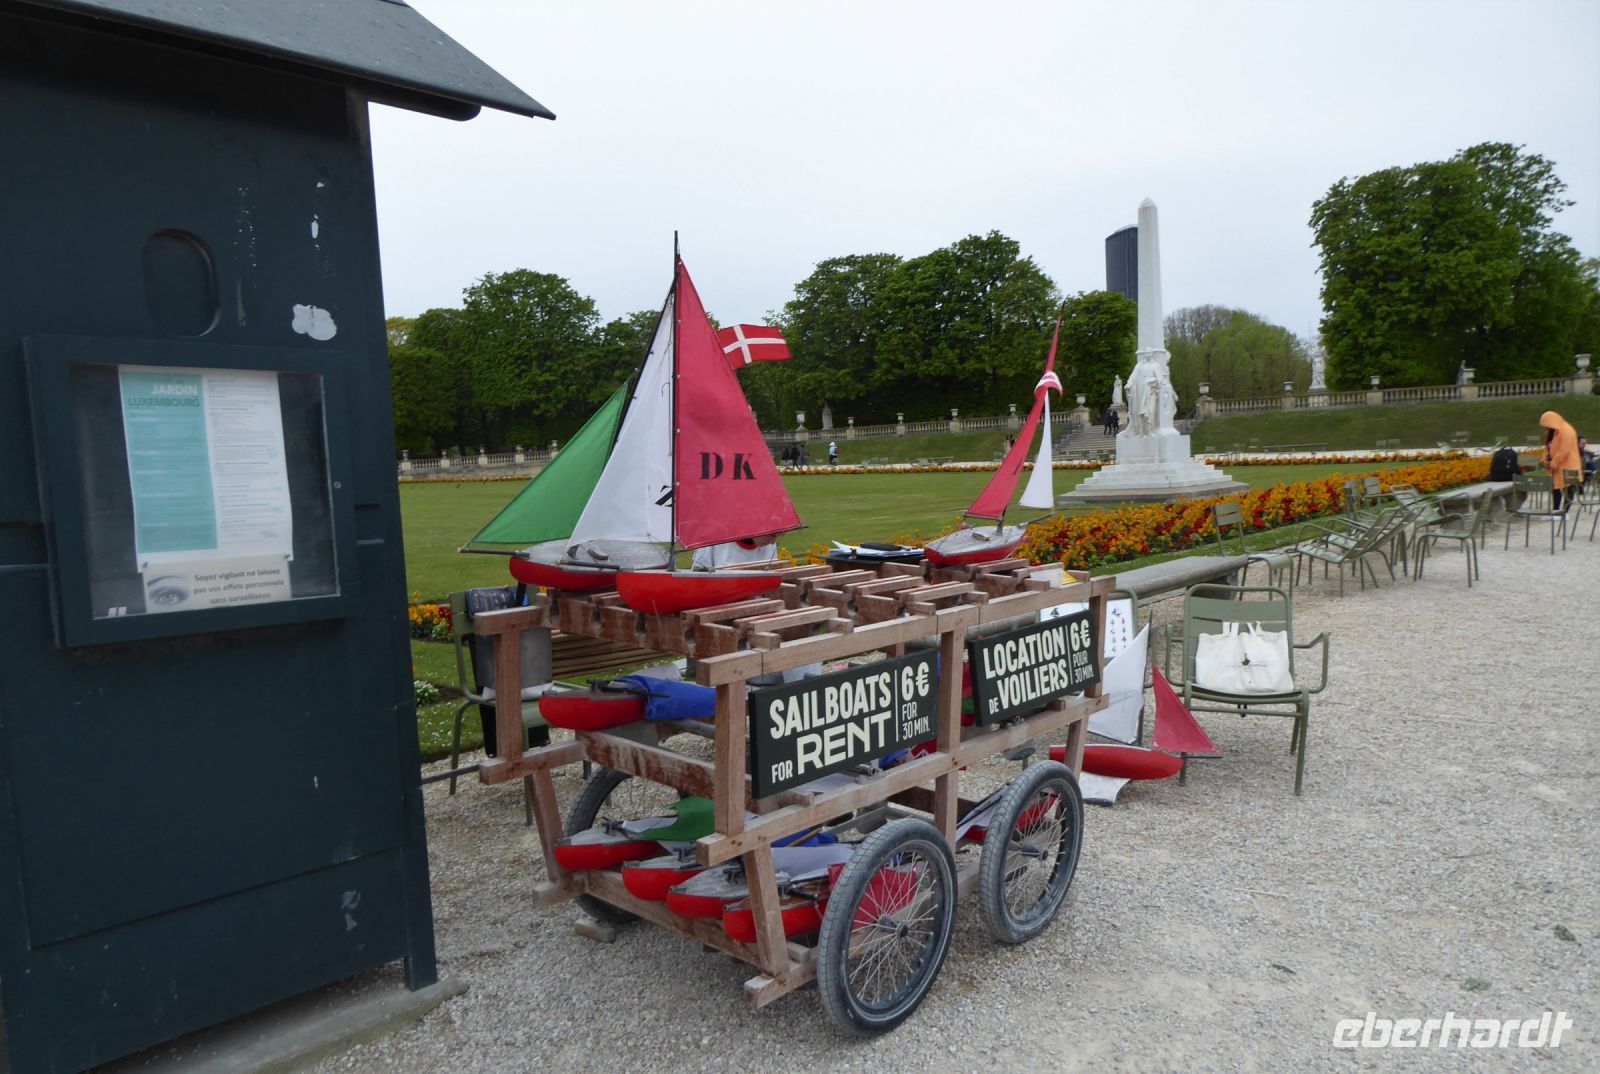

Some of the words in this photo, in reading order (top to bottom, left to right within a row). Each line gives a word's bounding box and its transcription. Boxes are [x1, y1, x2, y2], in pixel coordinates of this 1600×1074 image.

[152, 384, 198, 396] JARDIN
[219, 570, 245, 580] vigilant
[1070, 619, 1091, 652] 6€
[983, 626, 1066, 680] LOCATION
[1072, 650, 1088, 668] POUR
[1074, 667, 1083, 683] 30
[988, 697, 999, 715] DE
[997, 659, 1069, 710] VOILIERS
[769, 672, 892, 739] SAILBOATS
[902, 701, 918, 722] FOR
[902, 722, 914, 741] 30
[771, 759, 793, 784] FOR
[796, 711, 892, 775] RENT
